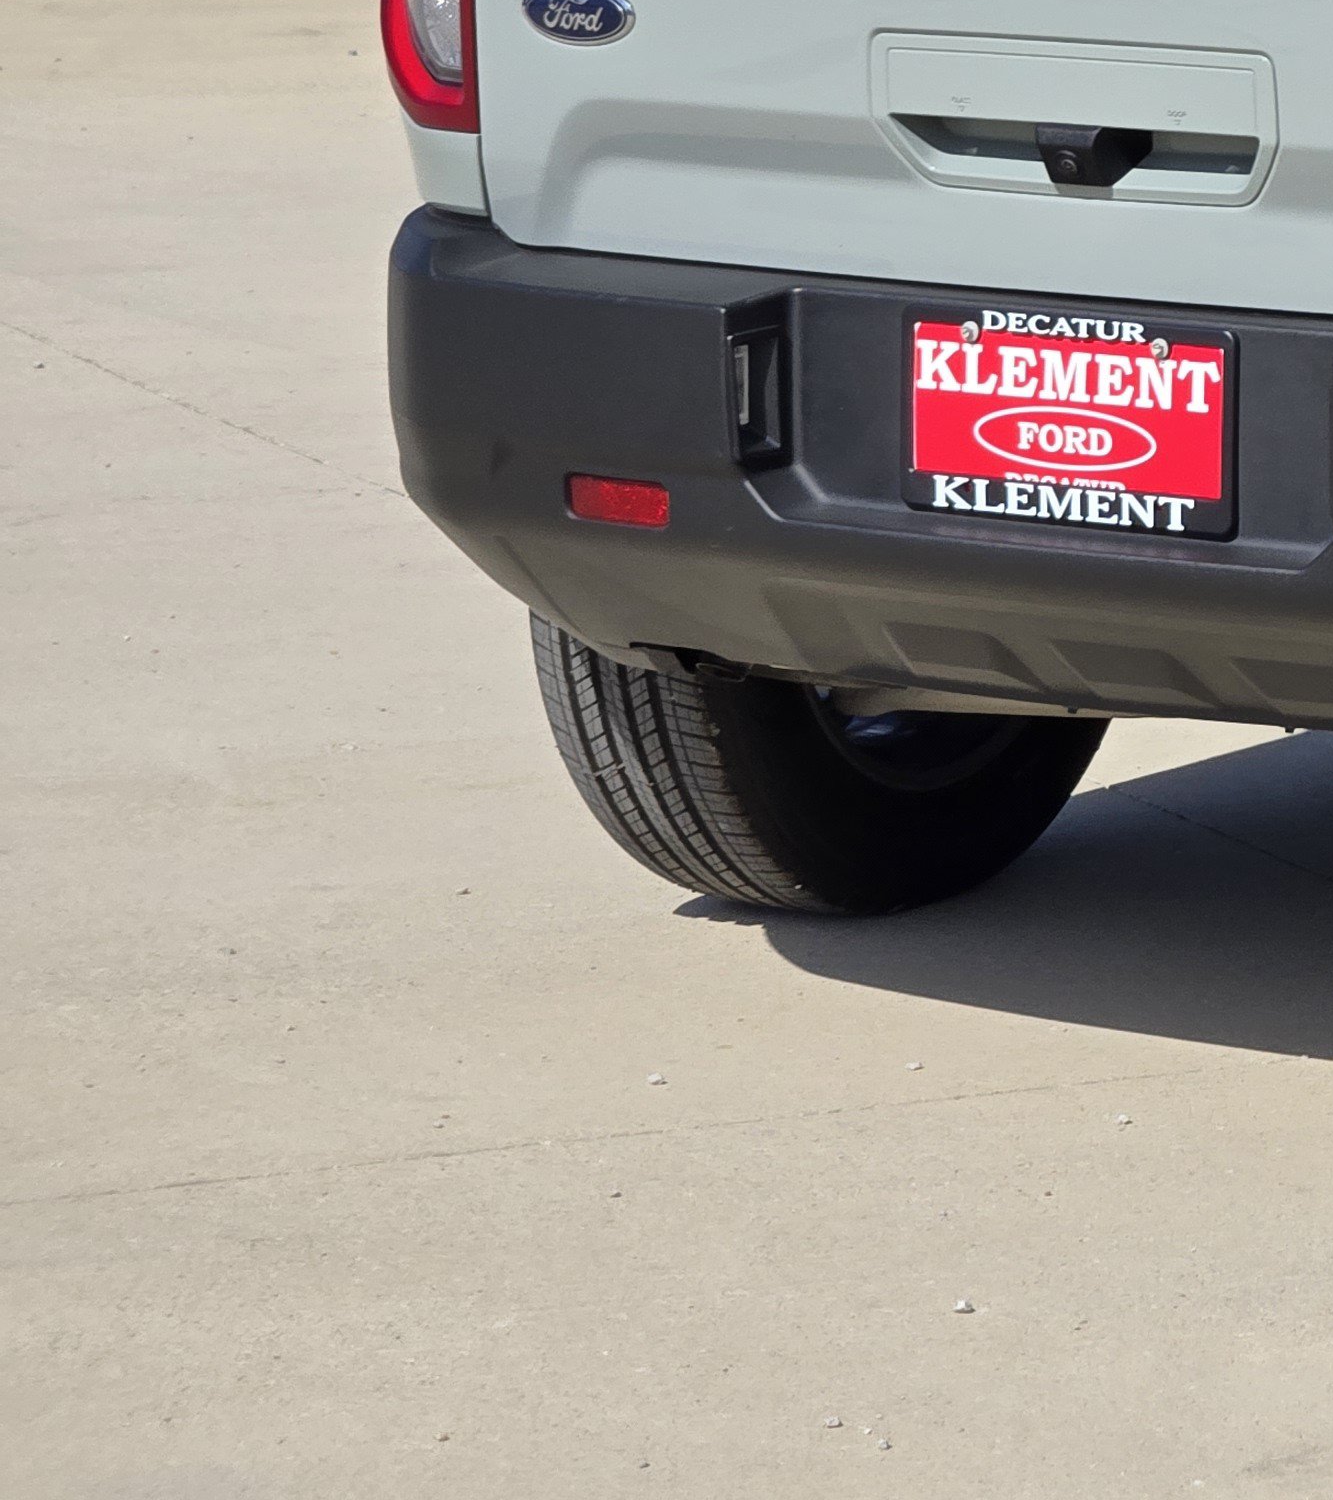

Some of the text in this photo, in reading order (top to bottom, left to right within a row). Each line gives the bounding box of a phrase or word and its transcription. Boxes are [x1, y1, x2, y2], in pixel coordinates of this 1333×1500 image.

[981, 310, 1147, 343] DECATUR
[914, 338, 1221, 414] KLEMENT
[1016, 420, 1114, 457] FORD
[931, 473, 1196, 532] KLEMENT
